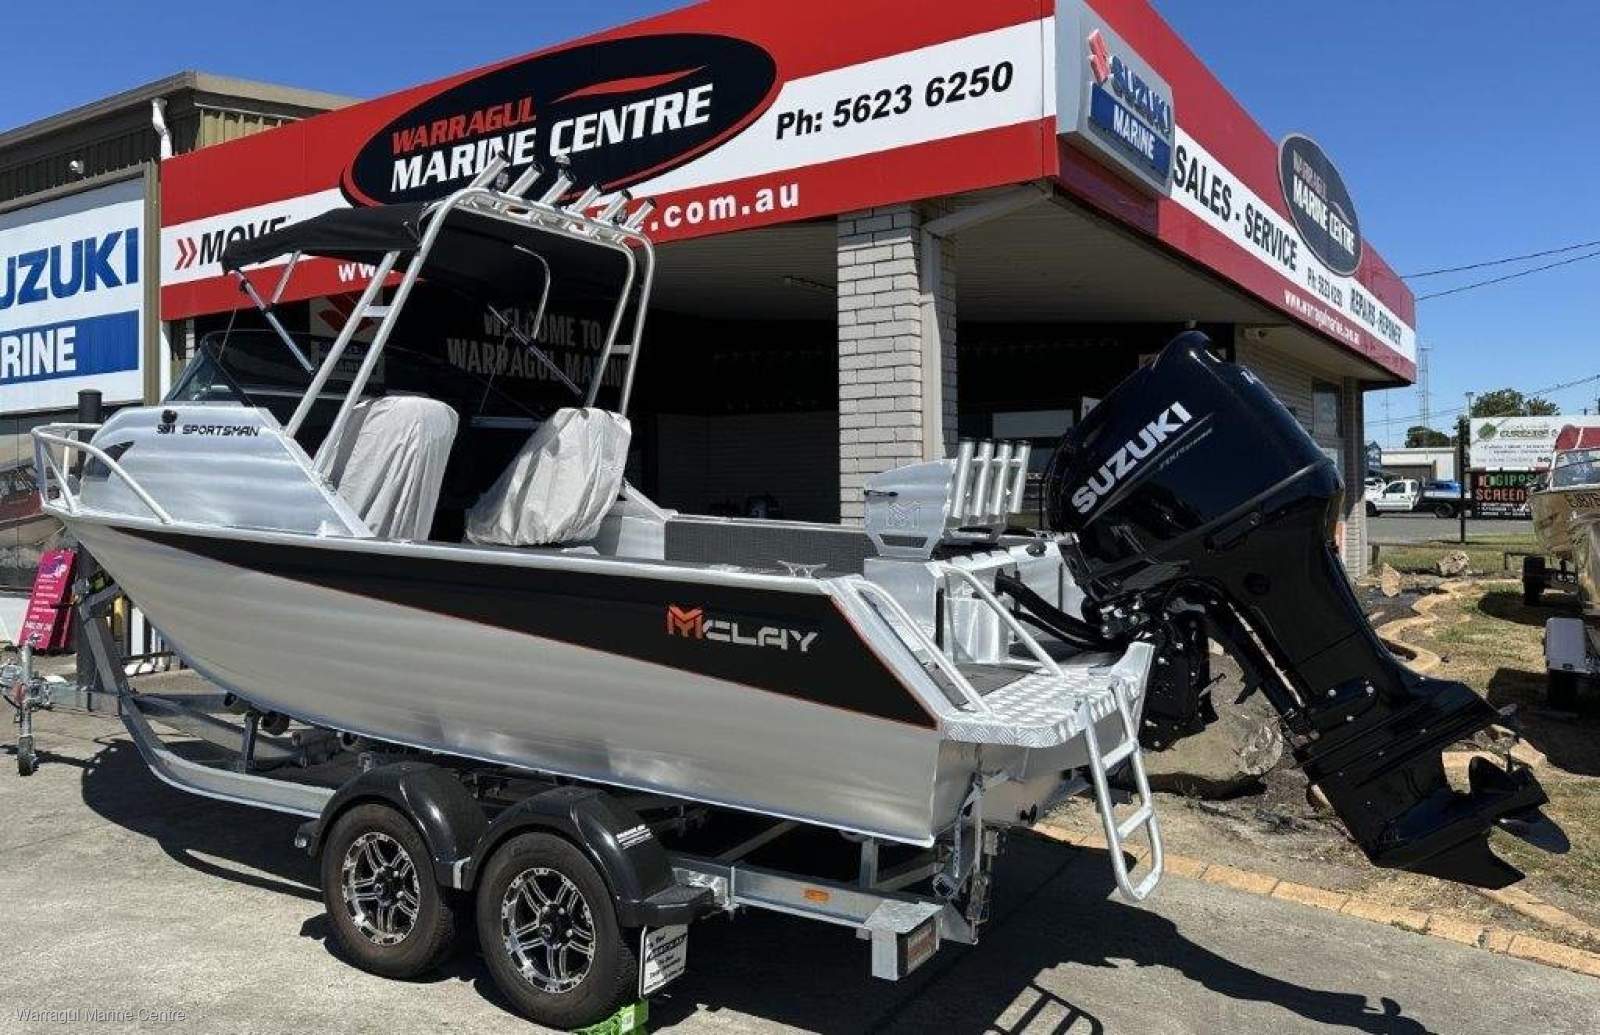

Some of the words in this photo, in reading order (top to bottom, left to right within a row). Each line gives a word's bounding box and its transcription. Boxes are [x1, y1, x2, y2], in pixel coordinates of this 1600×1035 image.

[392, 97, 537, 155] WARRAGUL
[776, 109, 823, 140] Ph:
[832, 84, 912, 128] 5623
[924, 61, 1014, 107] 6250
[390, 128, 537, 192] MARINE
[550, 83, 714, 157] CENTRE
[1113, 103, 1154, 160] MARINE
[1174, 145, 1232, 221] SALES
[1244, 202, 1297, 271] SERVICE
[1293, 174, 1328, 232] MARINE
[579, 319, 602, 351] TO
[182, 424, 260, 437] SPORTSMAN
[1071, 401, 1193, 514] SUZUKI
